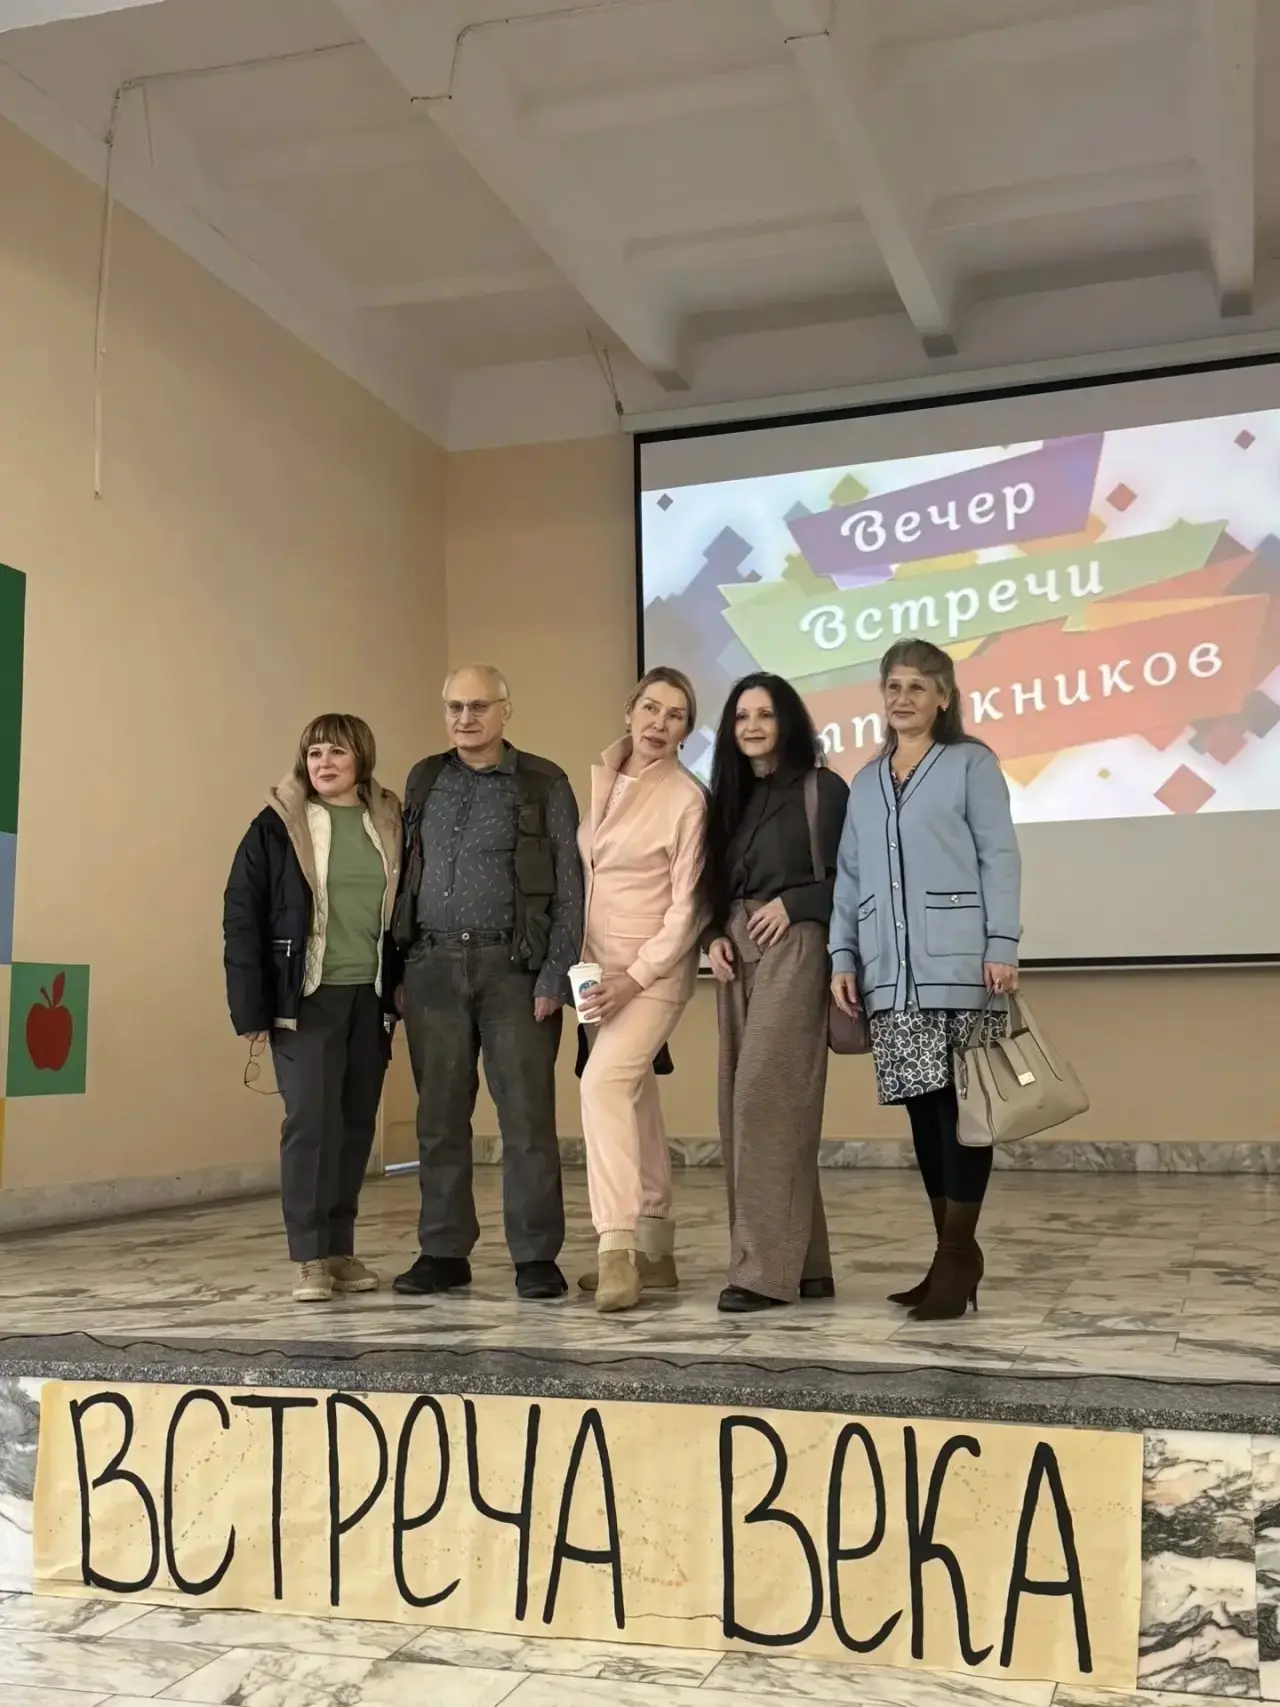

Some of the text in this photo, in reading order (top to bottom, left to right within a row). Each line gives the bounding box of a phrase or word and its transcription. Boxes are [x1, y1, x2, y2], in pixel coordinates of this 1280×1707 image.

[840, 482, 1035, 552] Вечер
[799, 560, 1104, 650] Встречи
[816, 642, 1223, 755] ыпкников
